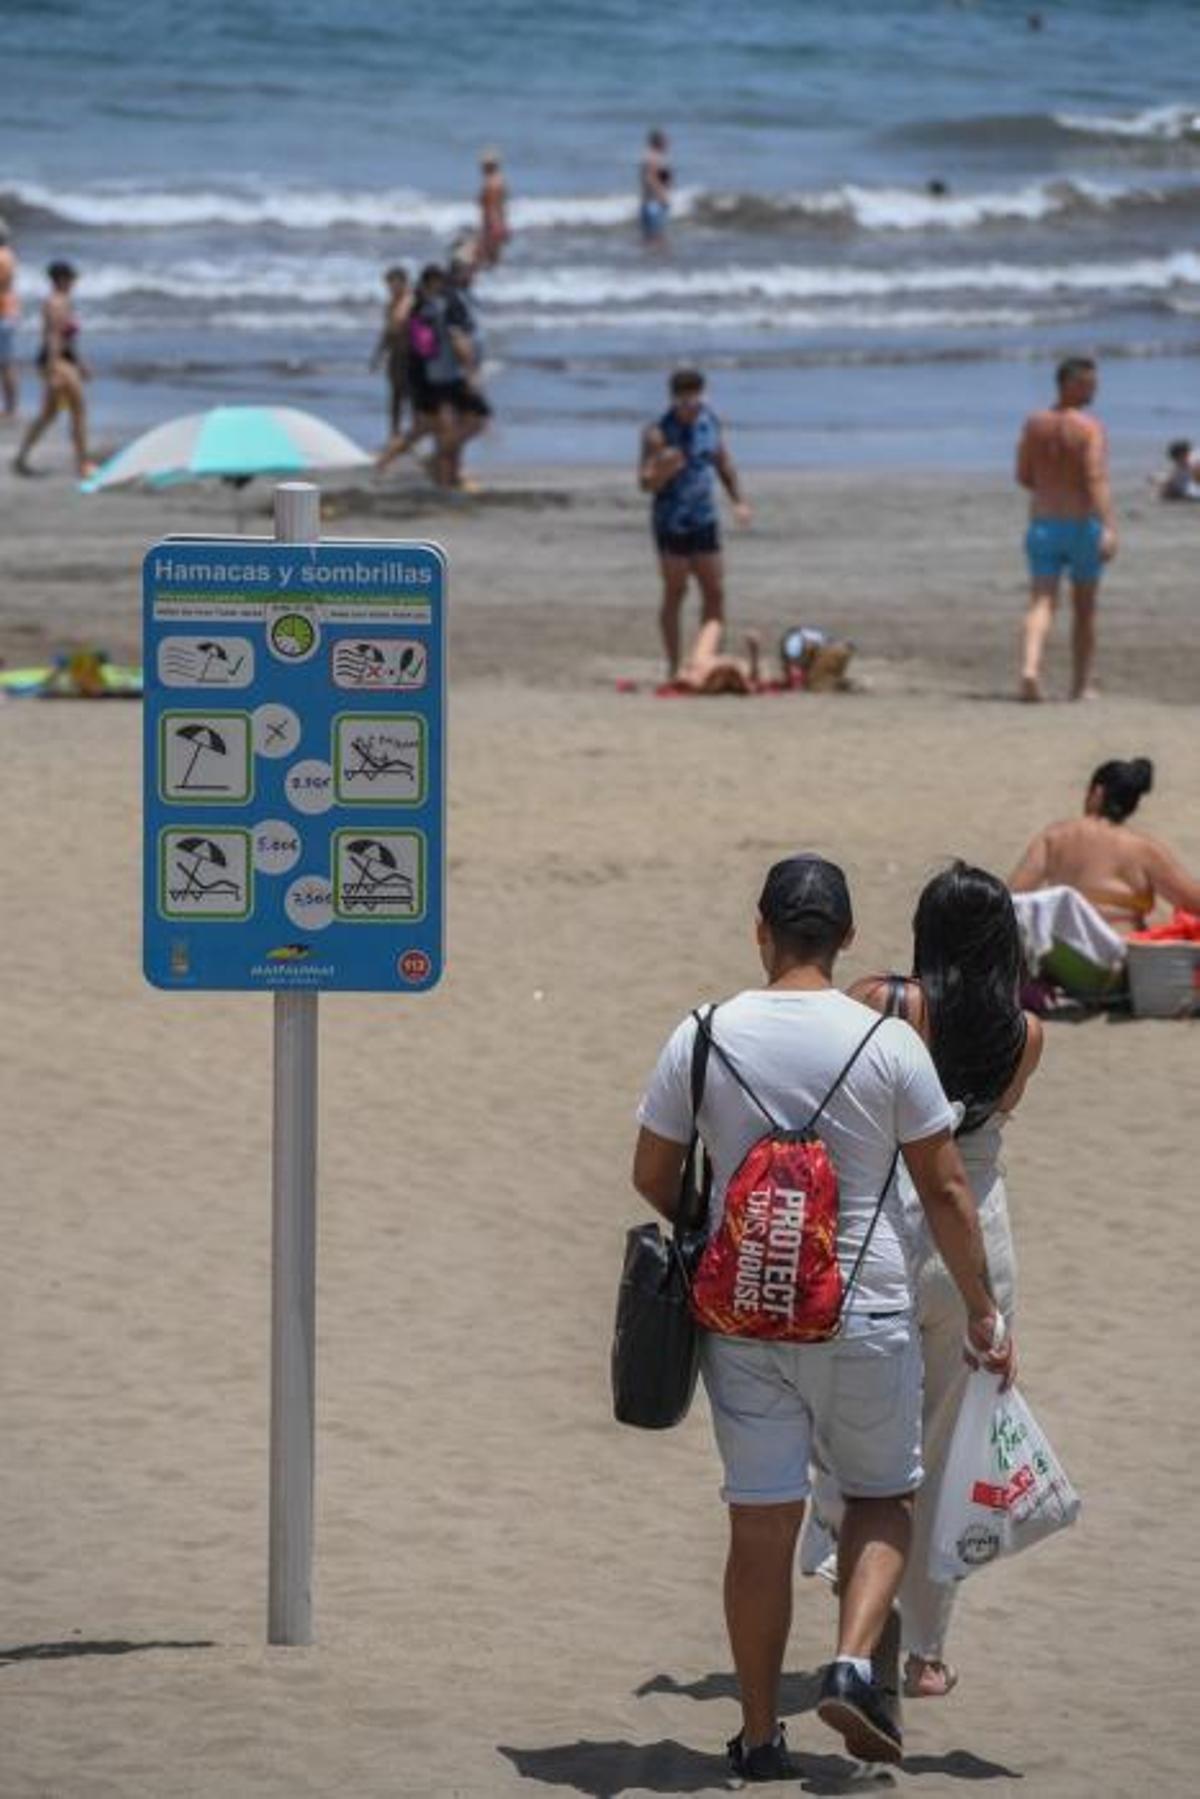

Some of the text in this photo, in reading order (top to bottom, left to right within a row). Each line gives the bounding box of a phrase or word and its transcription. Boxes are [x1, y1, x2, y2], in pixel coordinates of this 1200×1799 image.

[154, 558, 432, 588] Hamacas y sombrillas
[733, 1186, 772, 1315] THIS HOUSE
[761, 1187, 806, 1321] PROTECT
